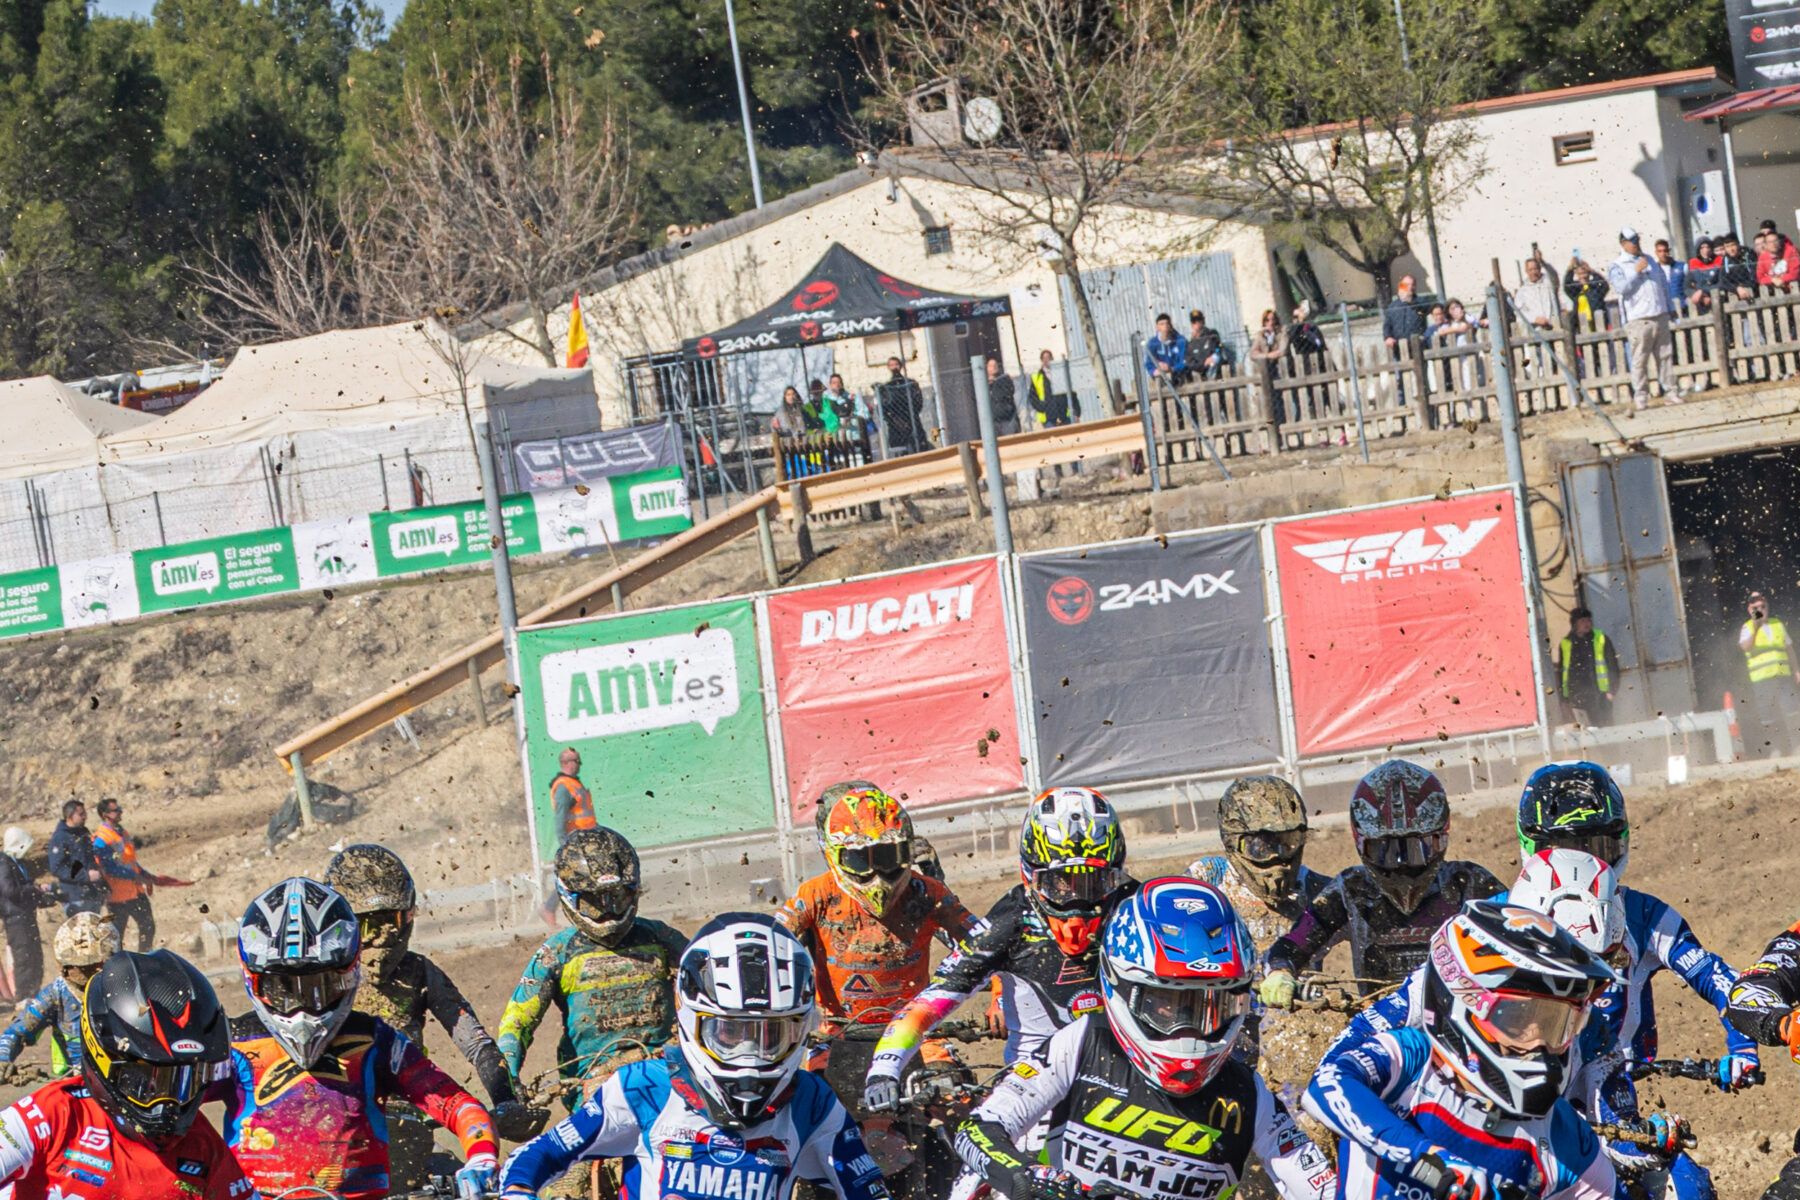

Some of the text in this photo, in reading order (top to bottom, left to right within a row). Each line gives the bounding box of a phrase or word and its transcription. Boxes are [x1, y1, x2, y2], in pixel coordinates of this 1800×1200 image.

[822, 317, 884, 336] 24MX
[718, 331, 780, 353] 24MX
[224, 542, 283, 560] El seguro
[1294, 517, 1501, 576] FLY
[1340, 560, 1461, 584] RACING
[7, 582, 49, 598] seguro
[1100, 570, 1241, 612] 24MX
[0, 605, 38, 618] ensamos
[800, 585, 974, 647] DUCATI
[177, 1042, 200, 1051] BELL
[1085, 1097, 1216, 1156] UFO
[1077, 1130, 1201, 1173] PLAST
[1062, 1136, 1157, 1194] TEAM
